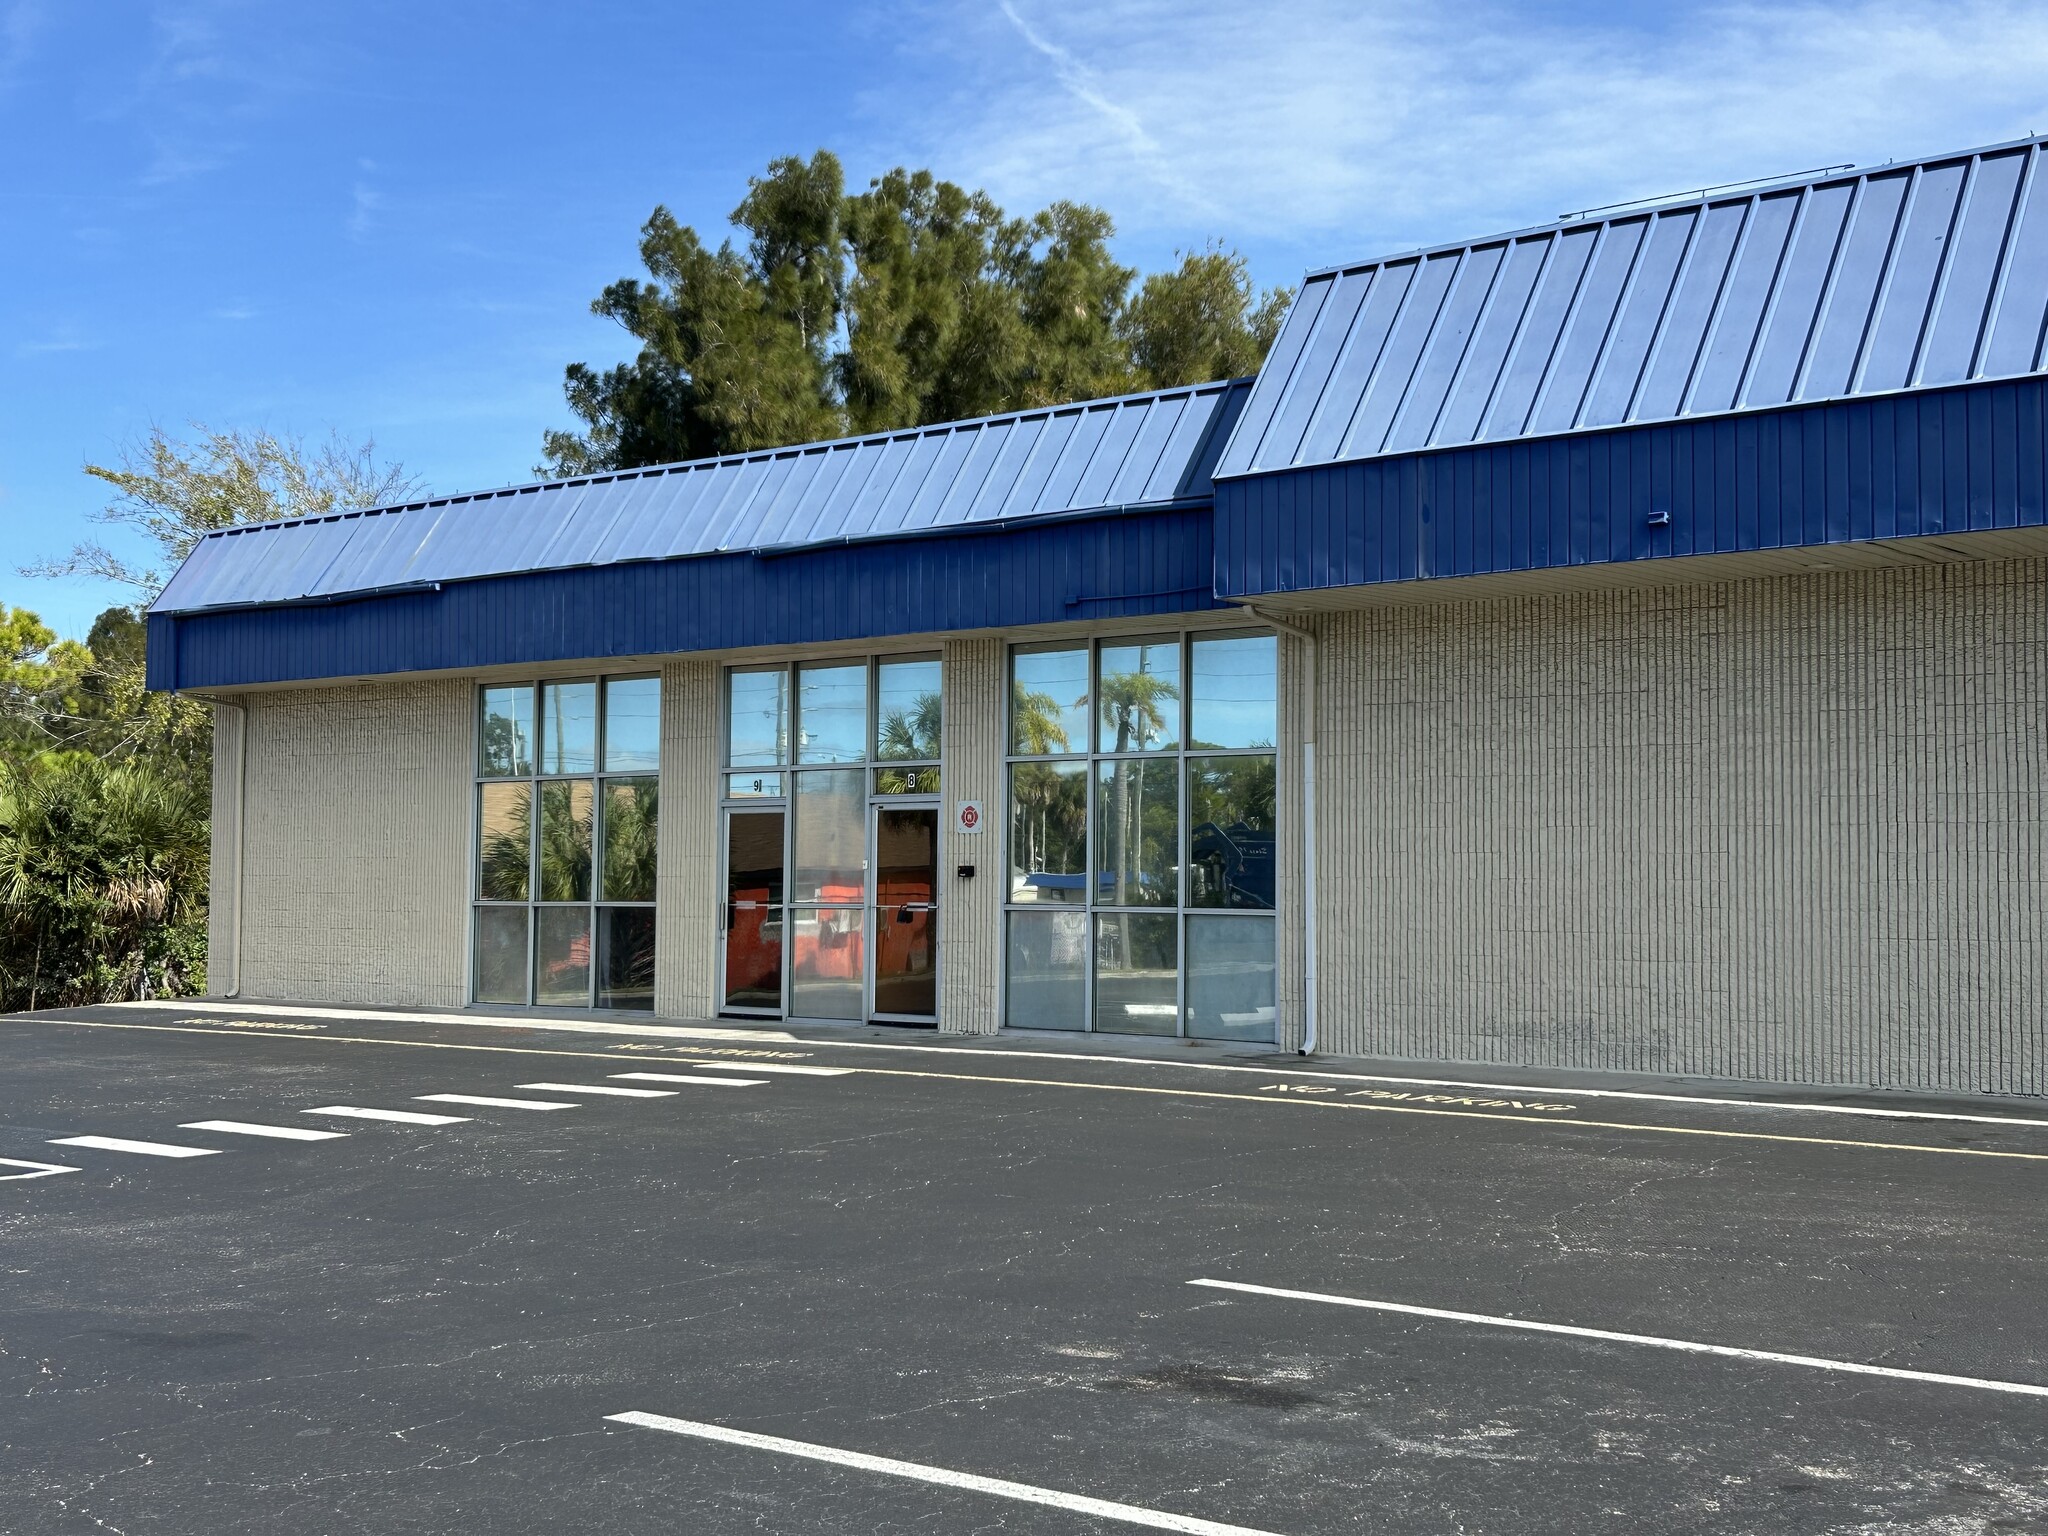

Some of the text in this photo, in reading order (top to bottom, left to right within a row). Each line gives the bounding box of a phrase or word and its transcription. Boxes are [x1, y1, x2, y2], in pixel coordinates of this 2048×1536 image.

[909, 774, 915, 787] 8
[1258, 1084, 1577, 1111] NO PARKING
